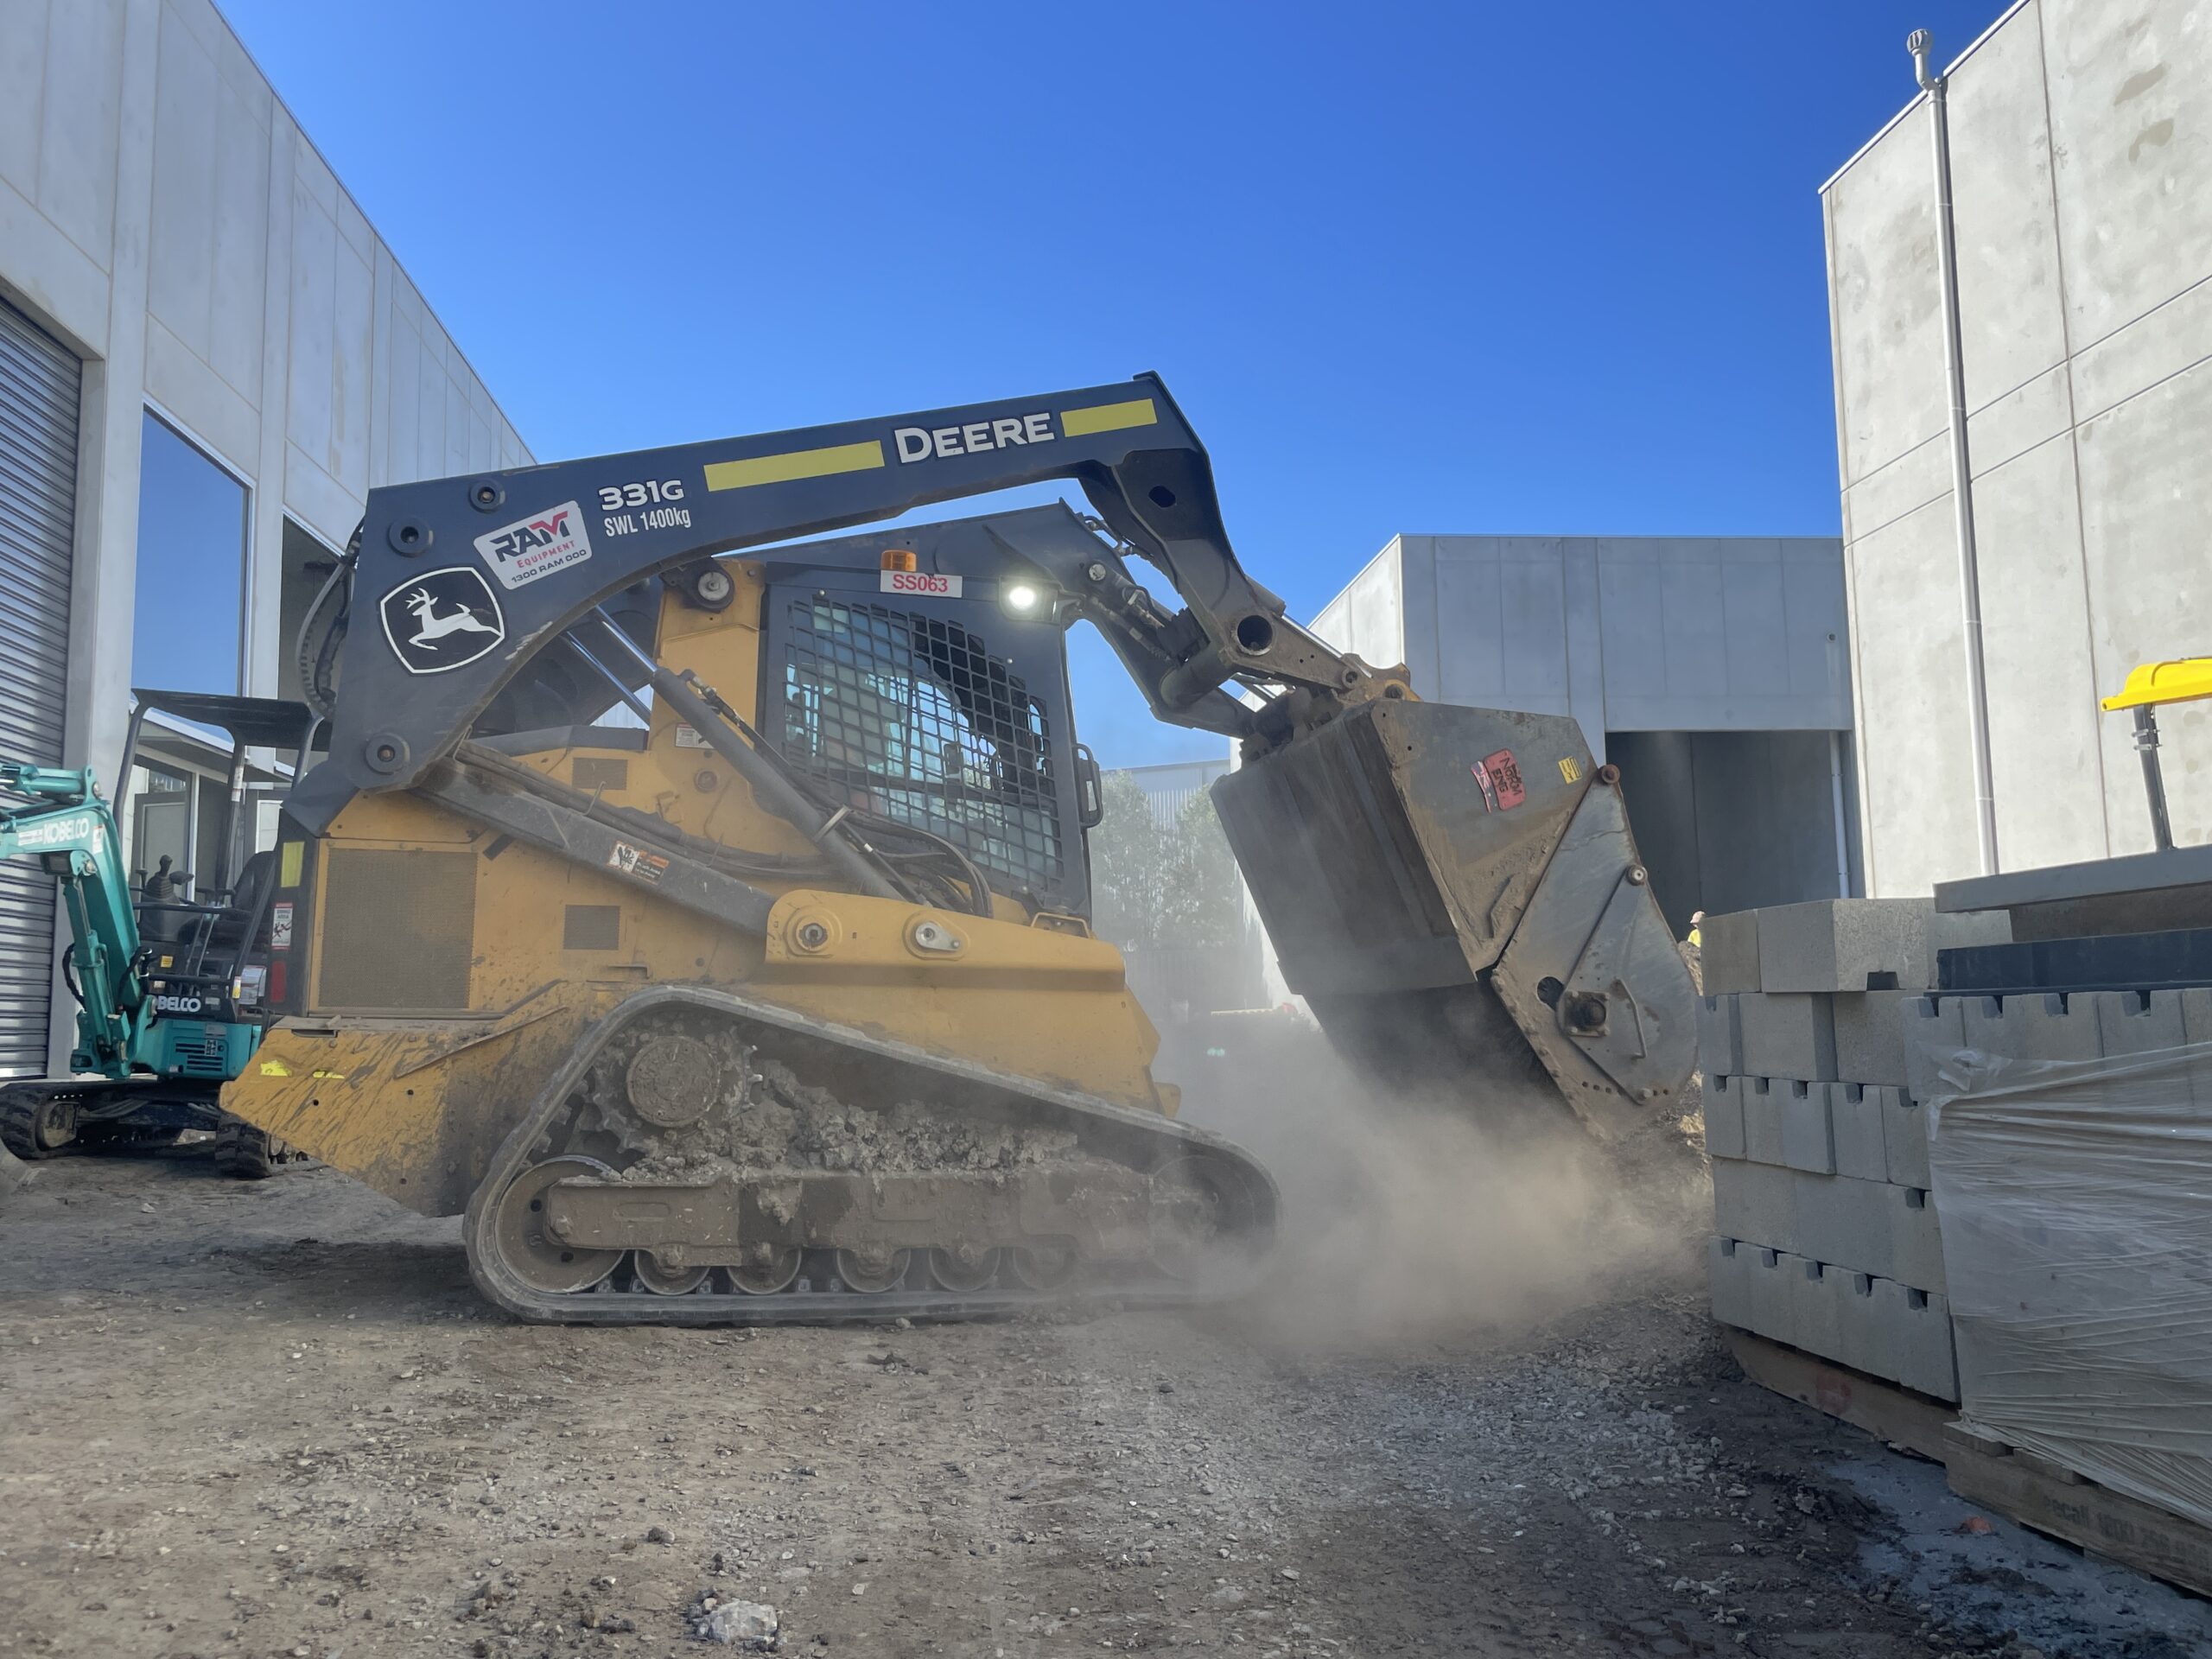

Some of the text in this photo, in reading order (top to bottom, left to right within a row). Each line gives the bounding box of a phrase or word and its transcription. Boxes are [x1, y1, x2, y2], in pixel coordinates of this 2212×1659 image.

[894, 412, 1055, 463] DEERE
[599, 480, 685, 511] 331G
[489, 511, 570, 563] RAM
[604, 507, 691, 537] SWL 1400kg
[511, 549, 588, 583] 1300 RAM 000
[517, 540, 575, 568] EQUIPMENT
[893, 574, 948, 593] SS063
[43, 817, 89, 844] KOBELCO
[156, 995, 201, 1013] BELCO
